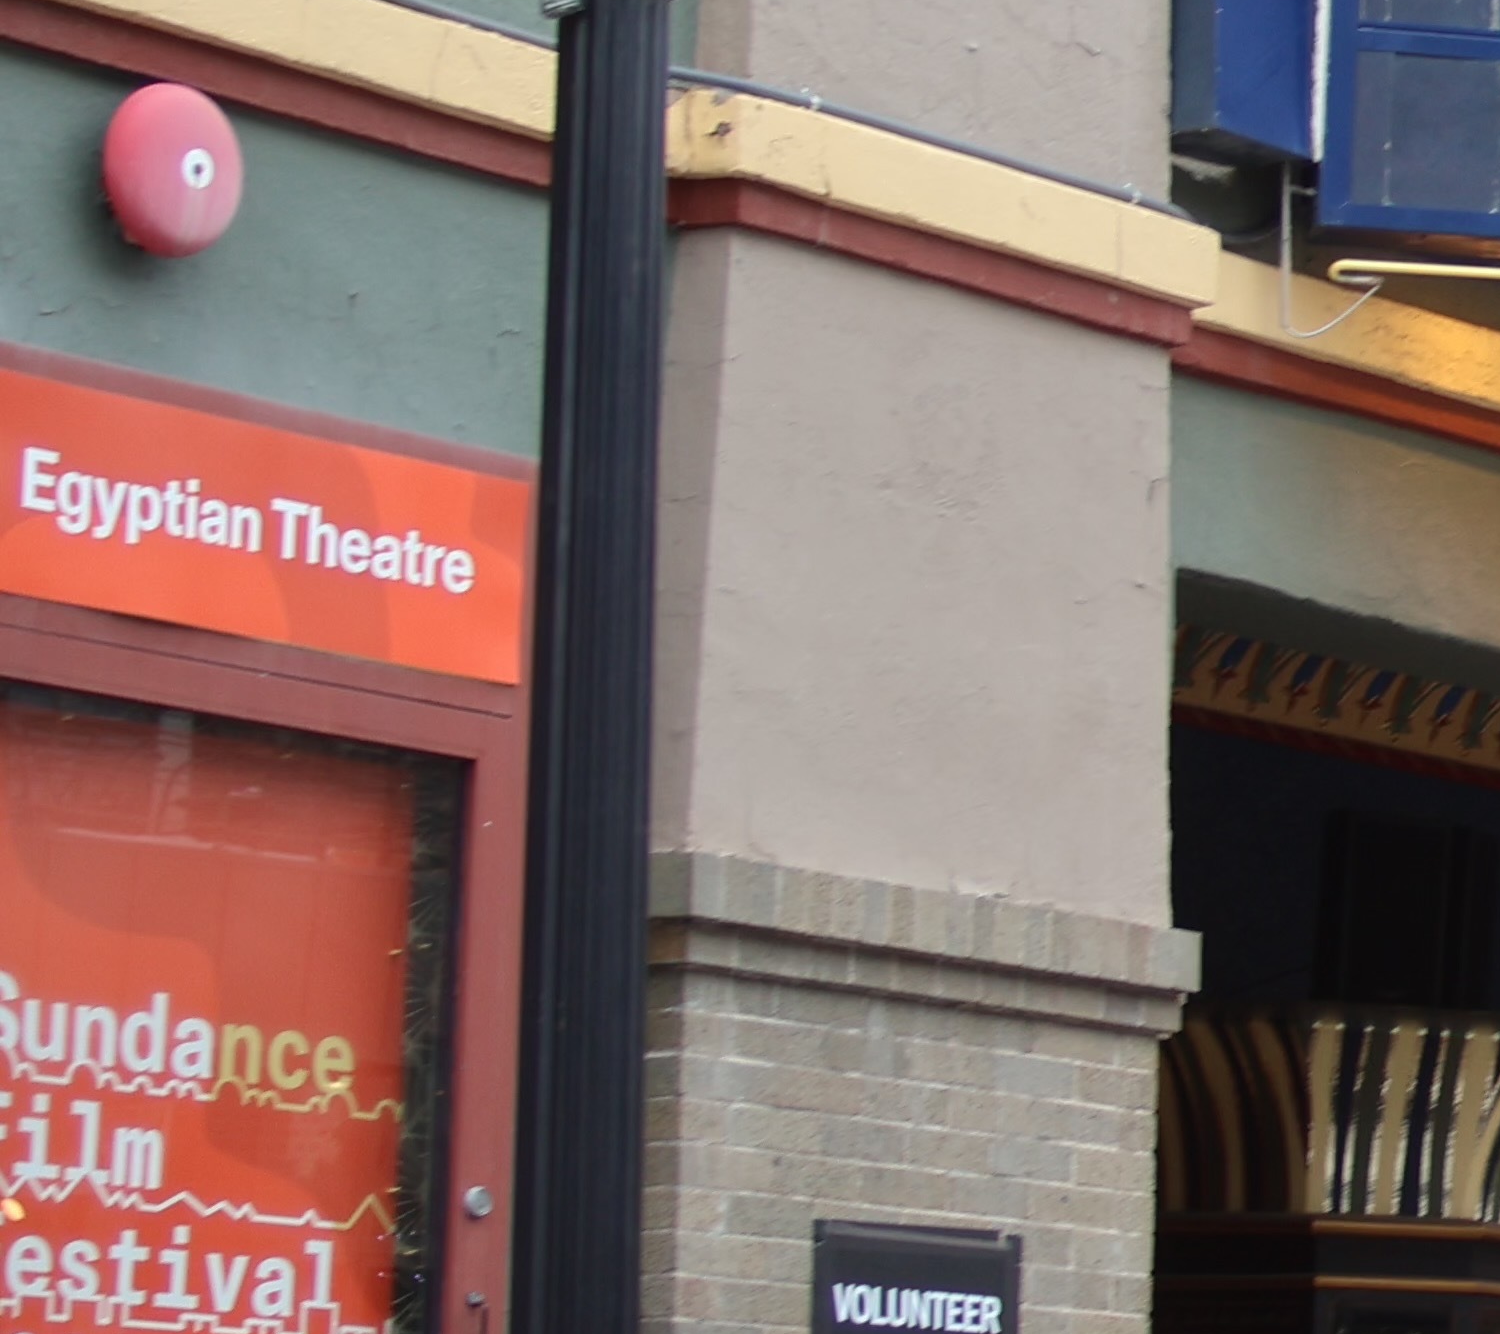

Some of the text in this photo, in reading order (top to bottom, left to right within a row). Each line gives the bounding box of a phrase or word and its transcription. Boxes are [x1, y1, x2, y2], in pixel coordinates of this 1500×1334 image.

[20, 446, 475, 594] Egyptian Theatre
[0, 1097, 164, 1189] ilm
[8, 1225, 336, 1317] estival
